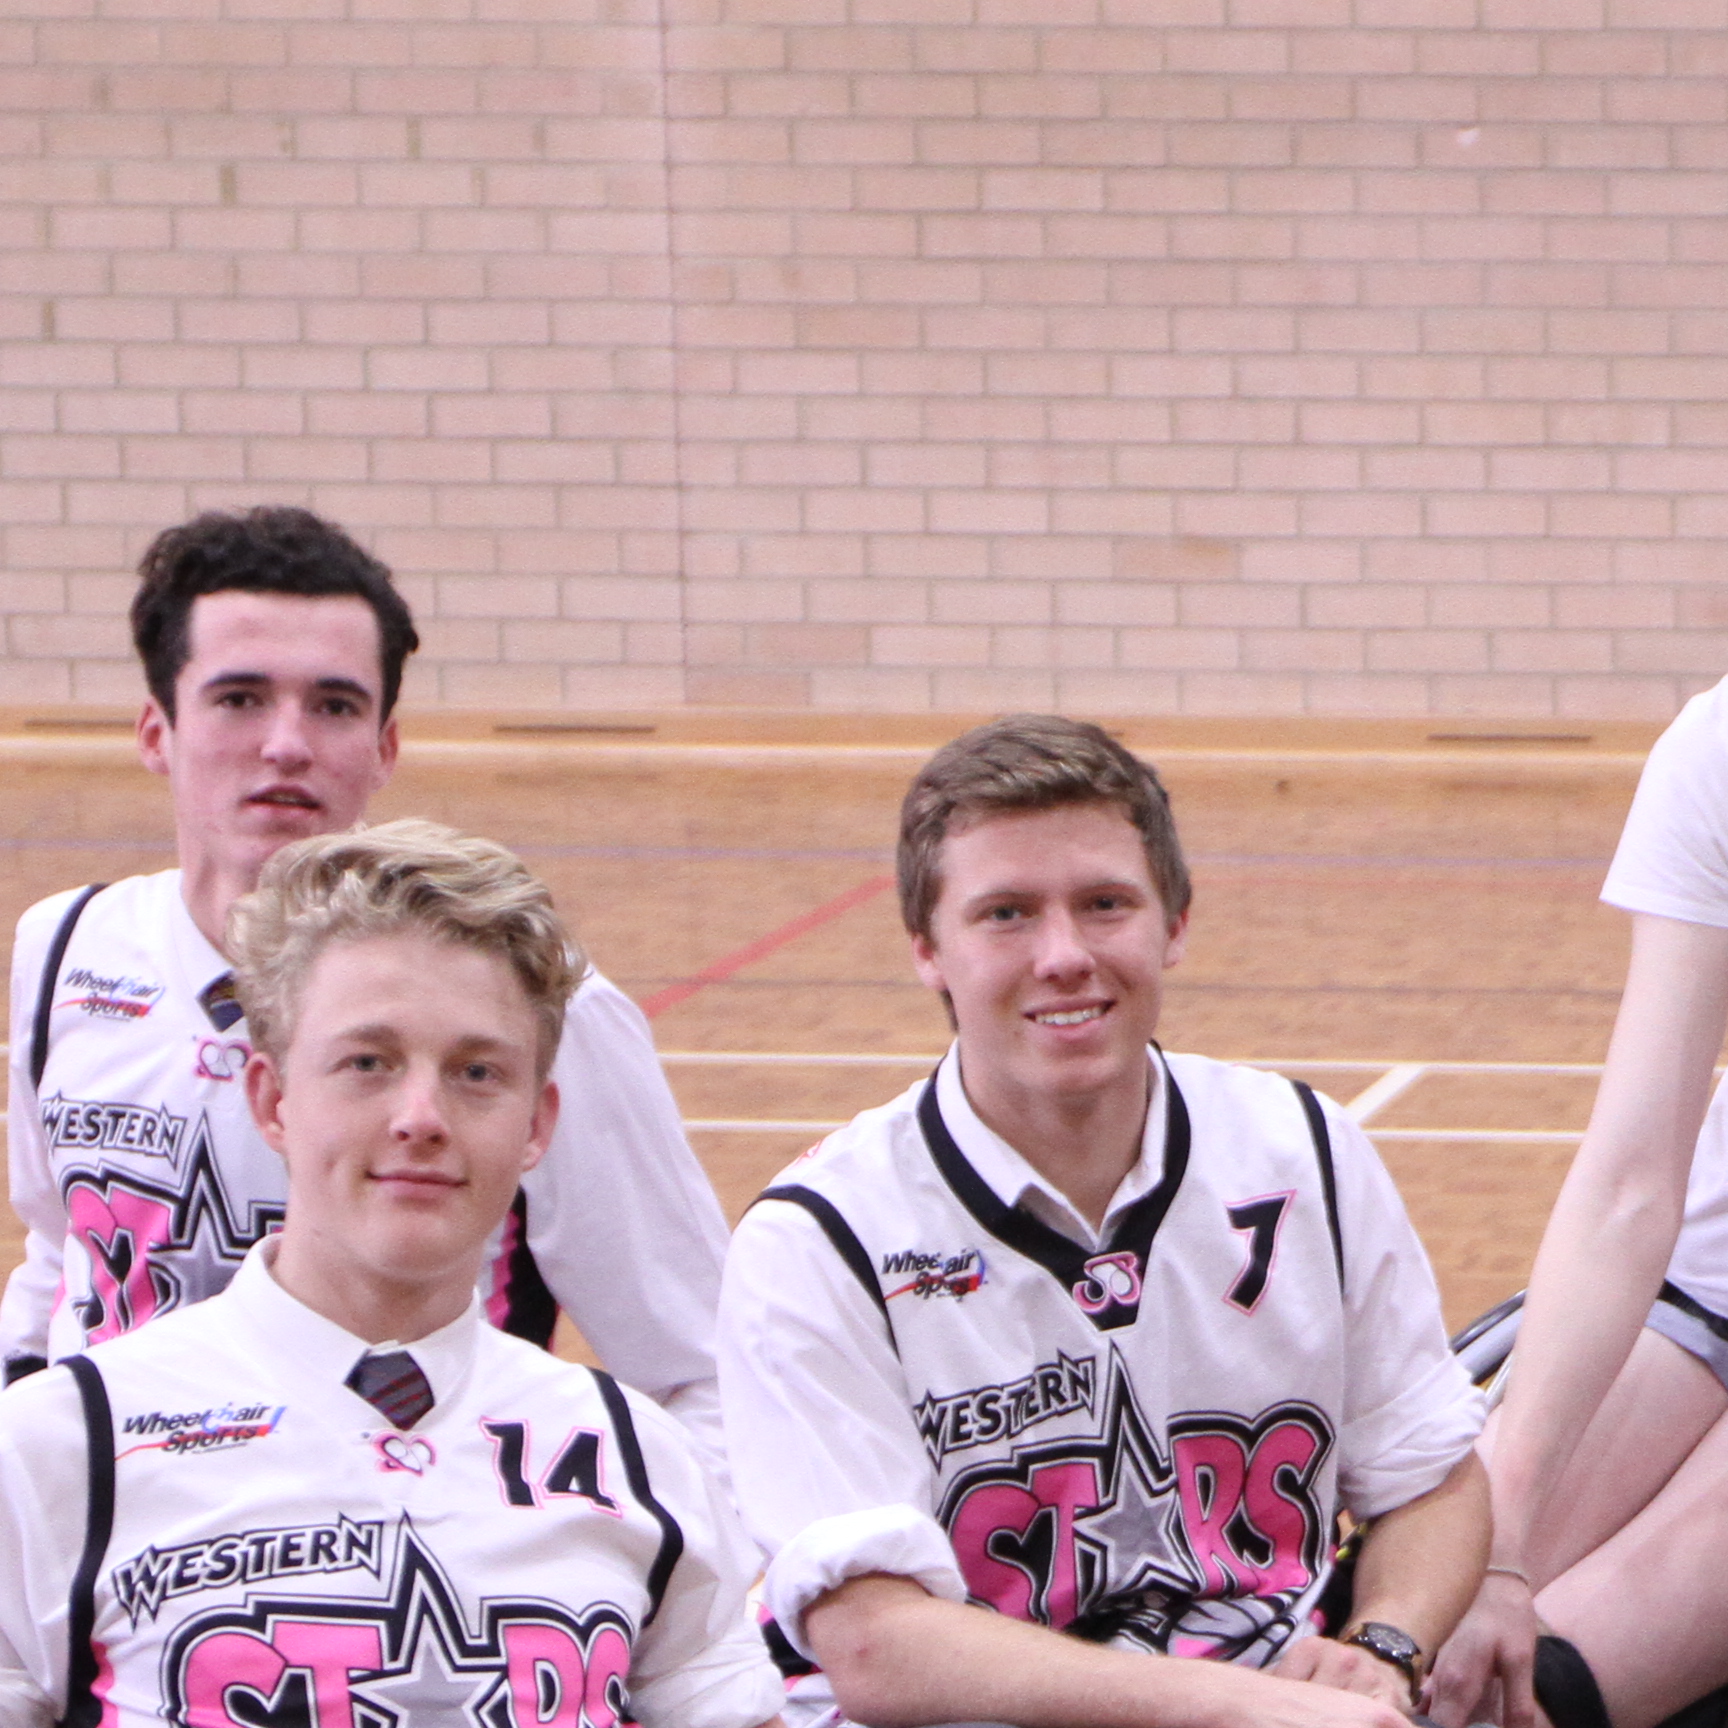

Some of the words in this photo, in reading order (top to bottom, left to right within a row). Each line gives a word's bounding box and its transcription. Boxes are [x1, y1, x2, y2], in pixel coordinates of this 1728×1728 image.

[42, 1095, 184, 1166] WESTERN
[1222, 1190, 1297, 1315] 7
[161, 1427, 261, 1455] Sports
[915, 1352, 1094, 1470] WESTERN
[481, 1418, 622, 1515] 14
[113, 1518, 384, 1624] WESTERN
